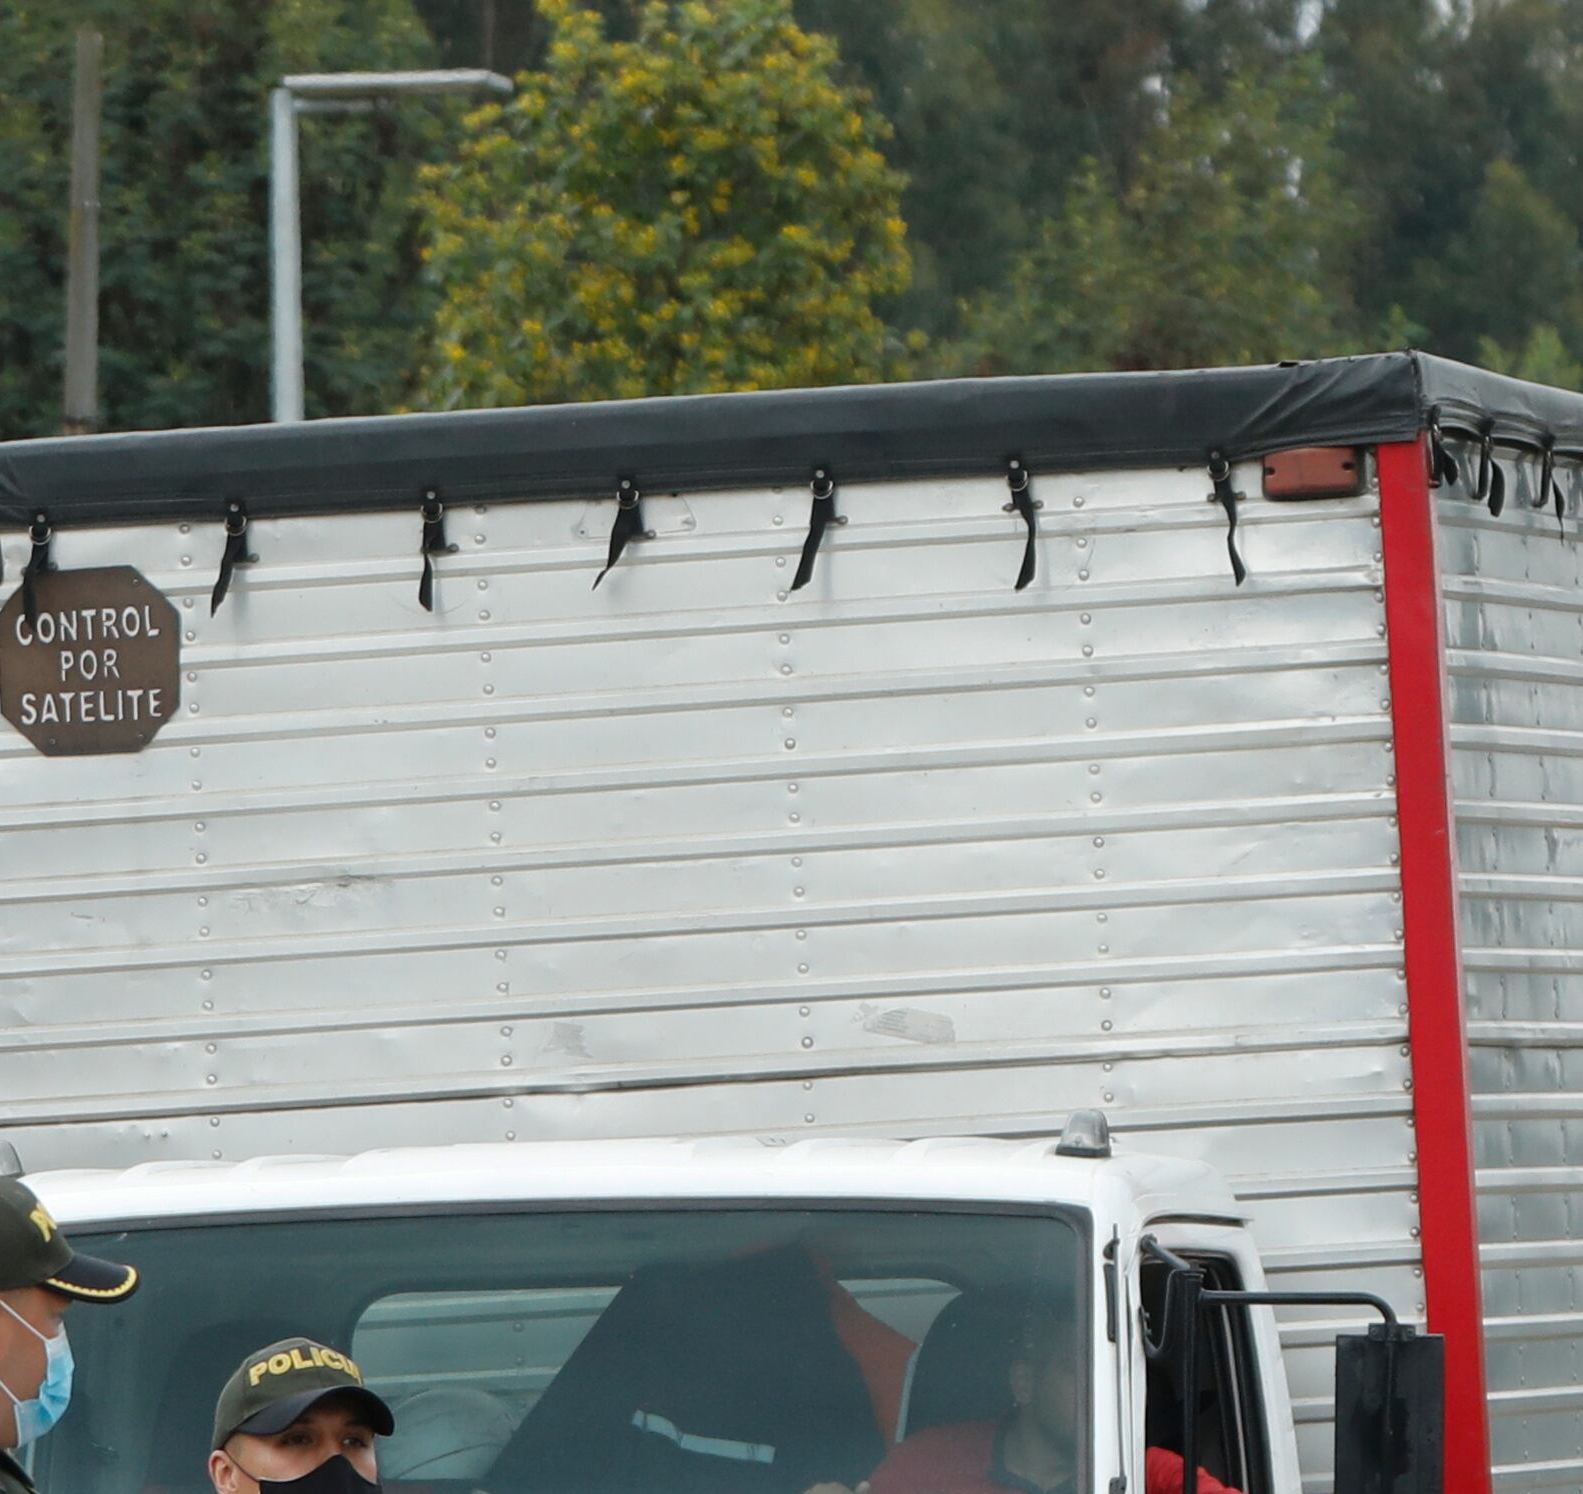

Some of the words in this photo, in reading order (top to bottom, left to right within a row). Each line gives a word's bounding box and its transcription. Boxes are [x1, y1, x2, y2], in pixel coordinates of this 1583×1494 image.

[16, 605, 160, 647] CONTROL
[61, 648, 120, 681] POR
[21, 688, 163, 726] SATELITE
